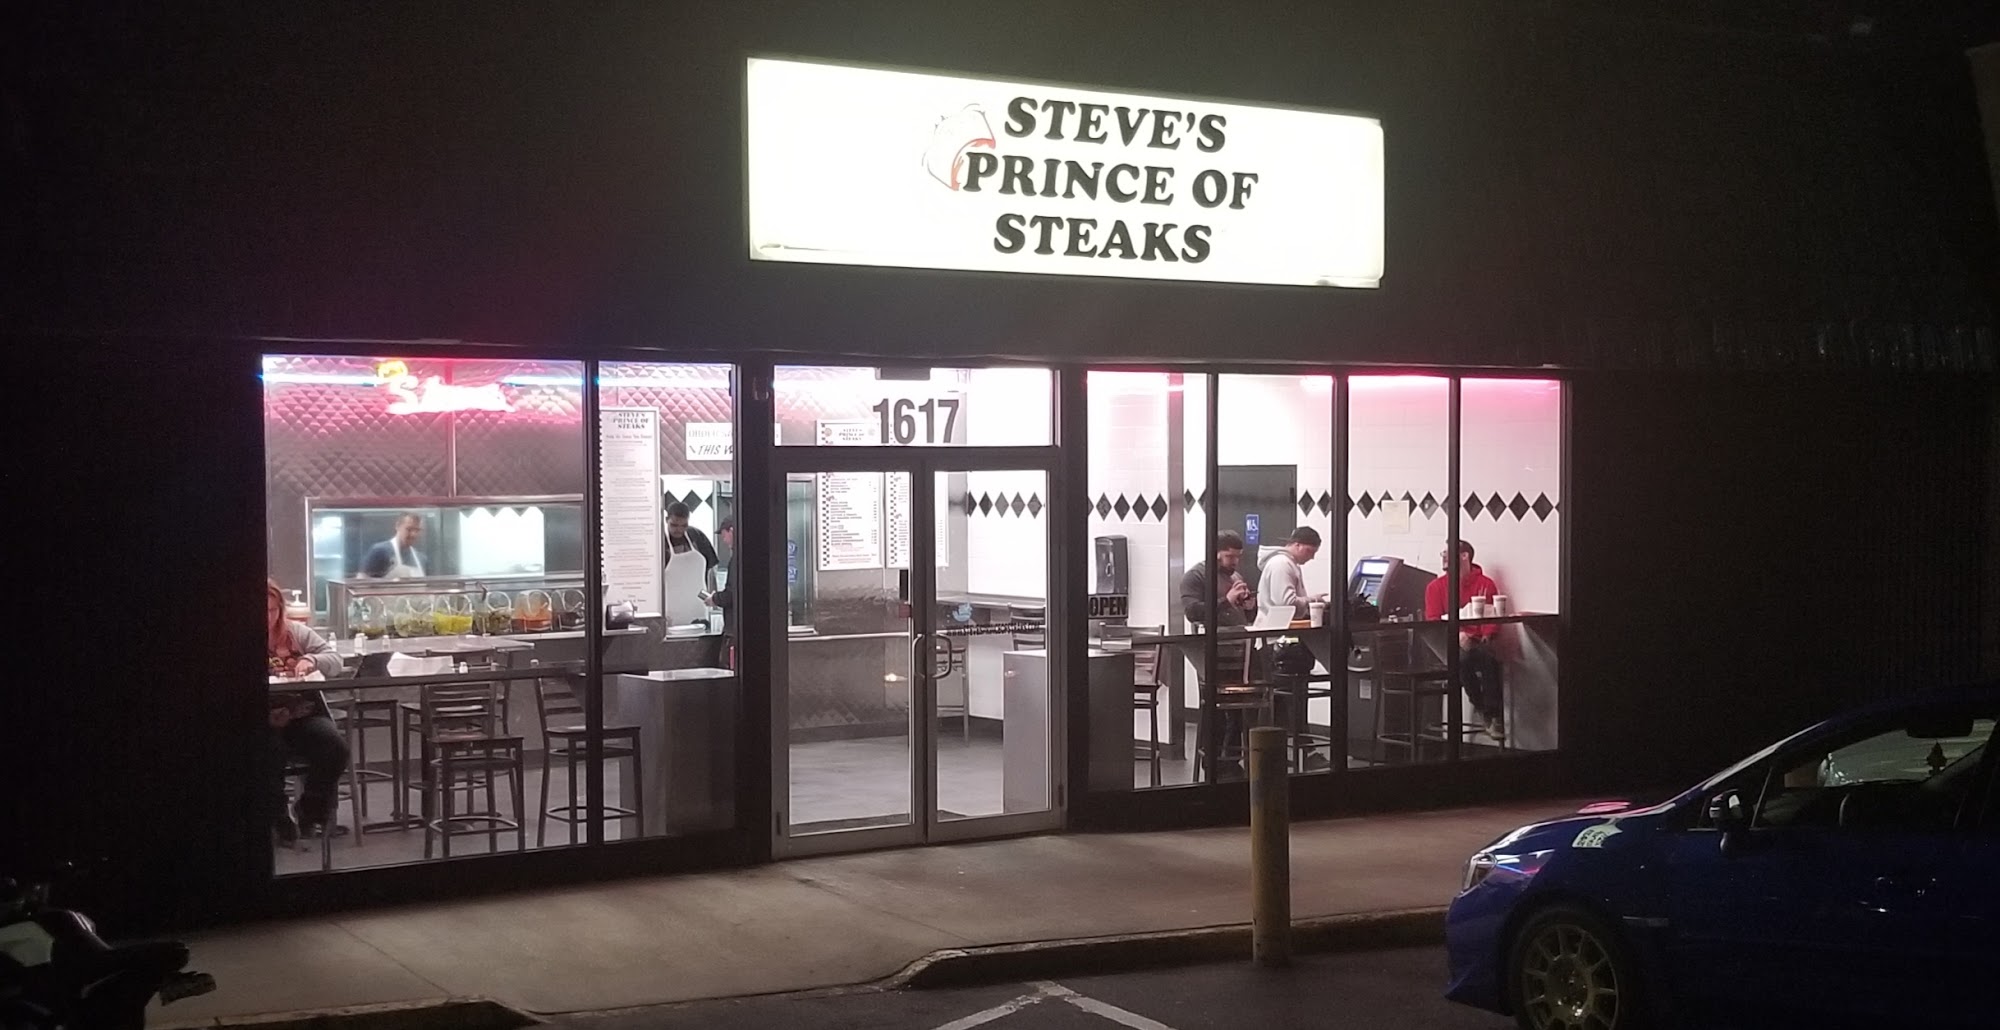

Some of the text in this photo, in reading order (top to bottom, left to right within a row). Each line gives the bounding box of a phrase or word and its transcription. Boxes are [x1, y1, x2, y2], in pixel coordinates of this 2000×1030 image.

[1004, 96, 1227, 152] STEVE'S
[962, 151, 1259, 210] PRINCE OF
[993, 213, 1212, 264] STEAKS
[872, 397, 960, 445] 1617
[698, 444, 721, 455] THIS
[1090, 596, 1127, 617] OPEN
